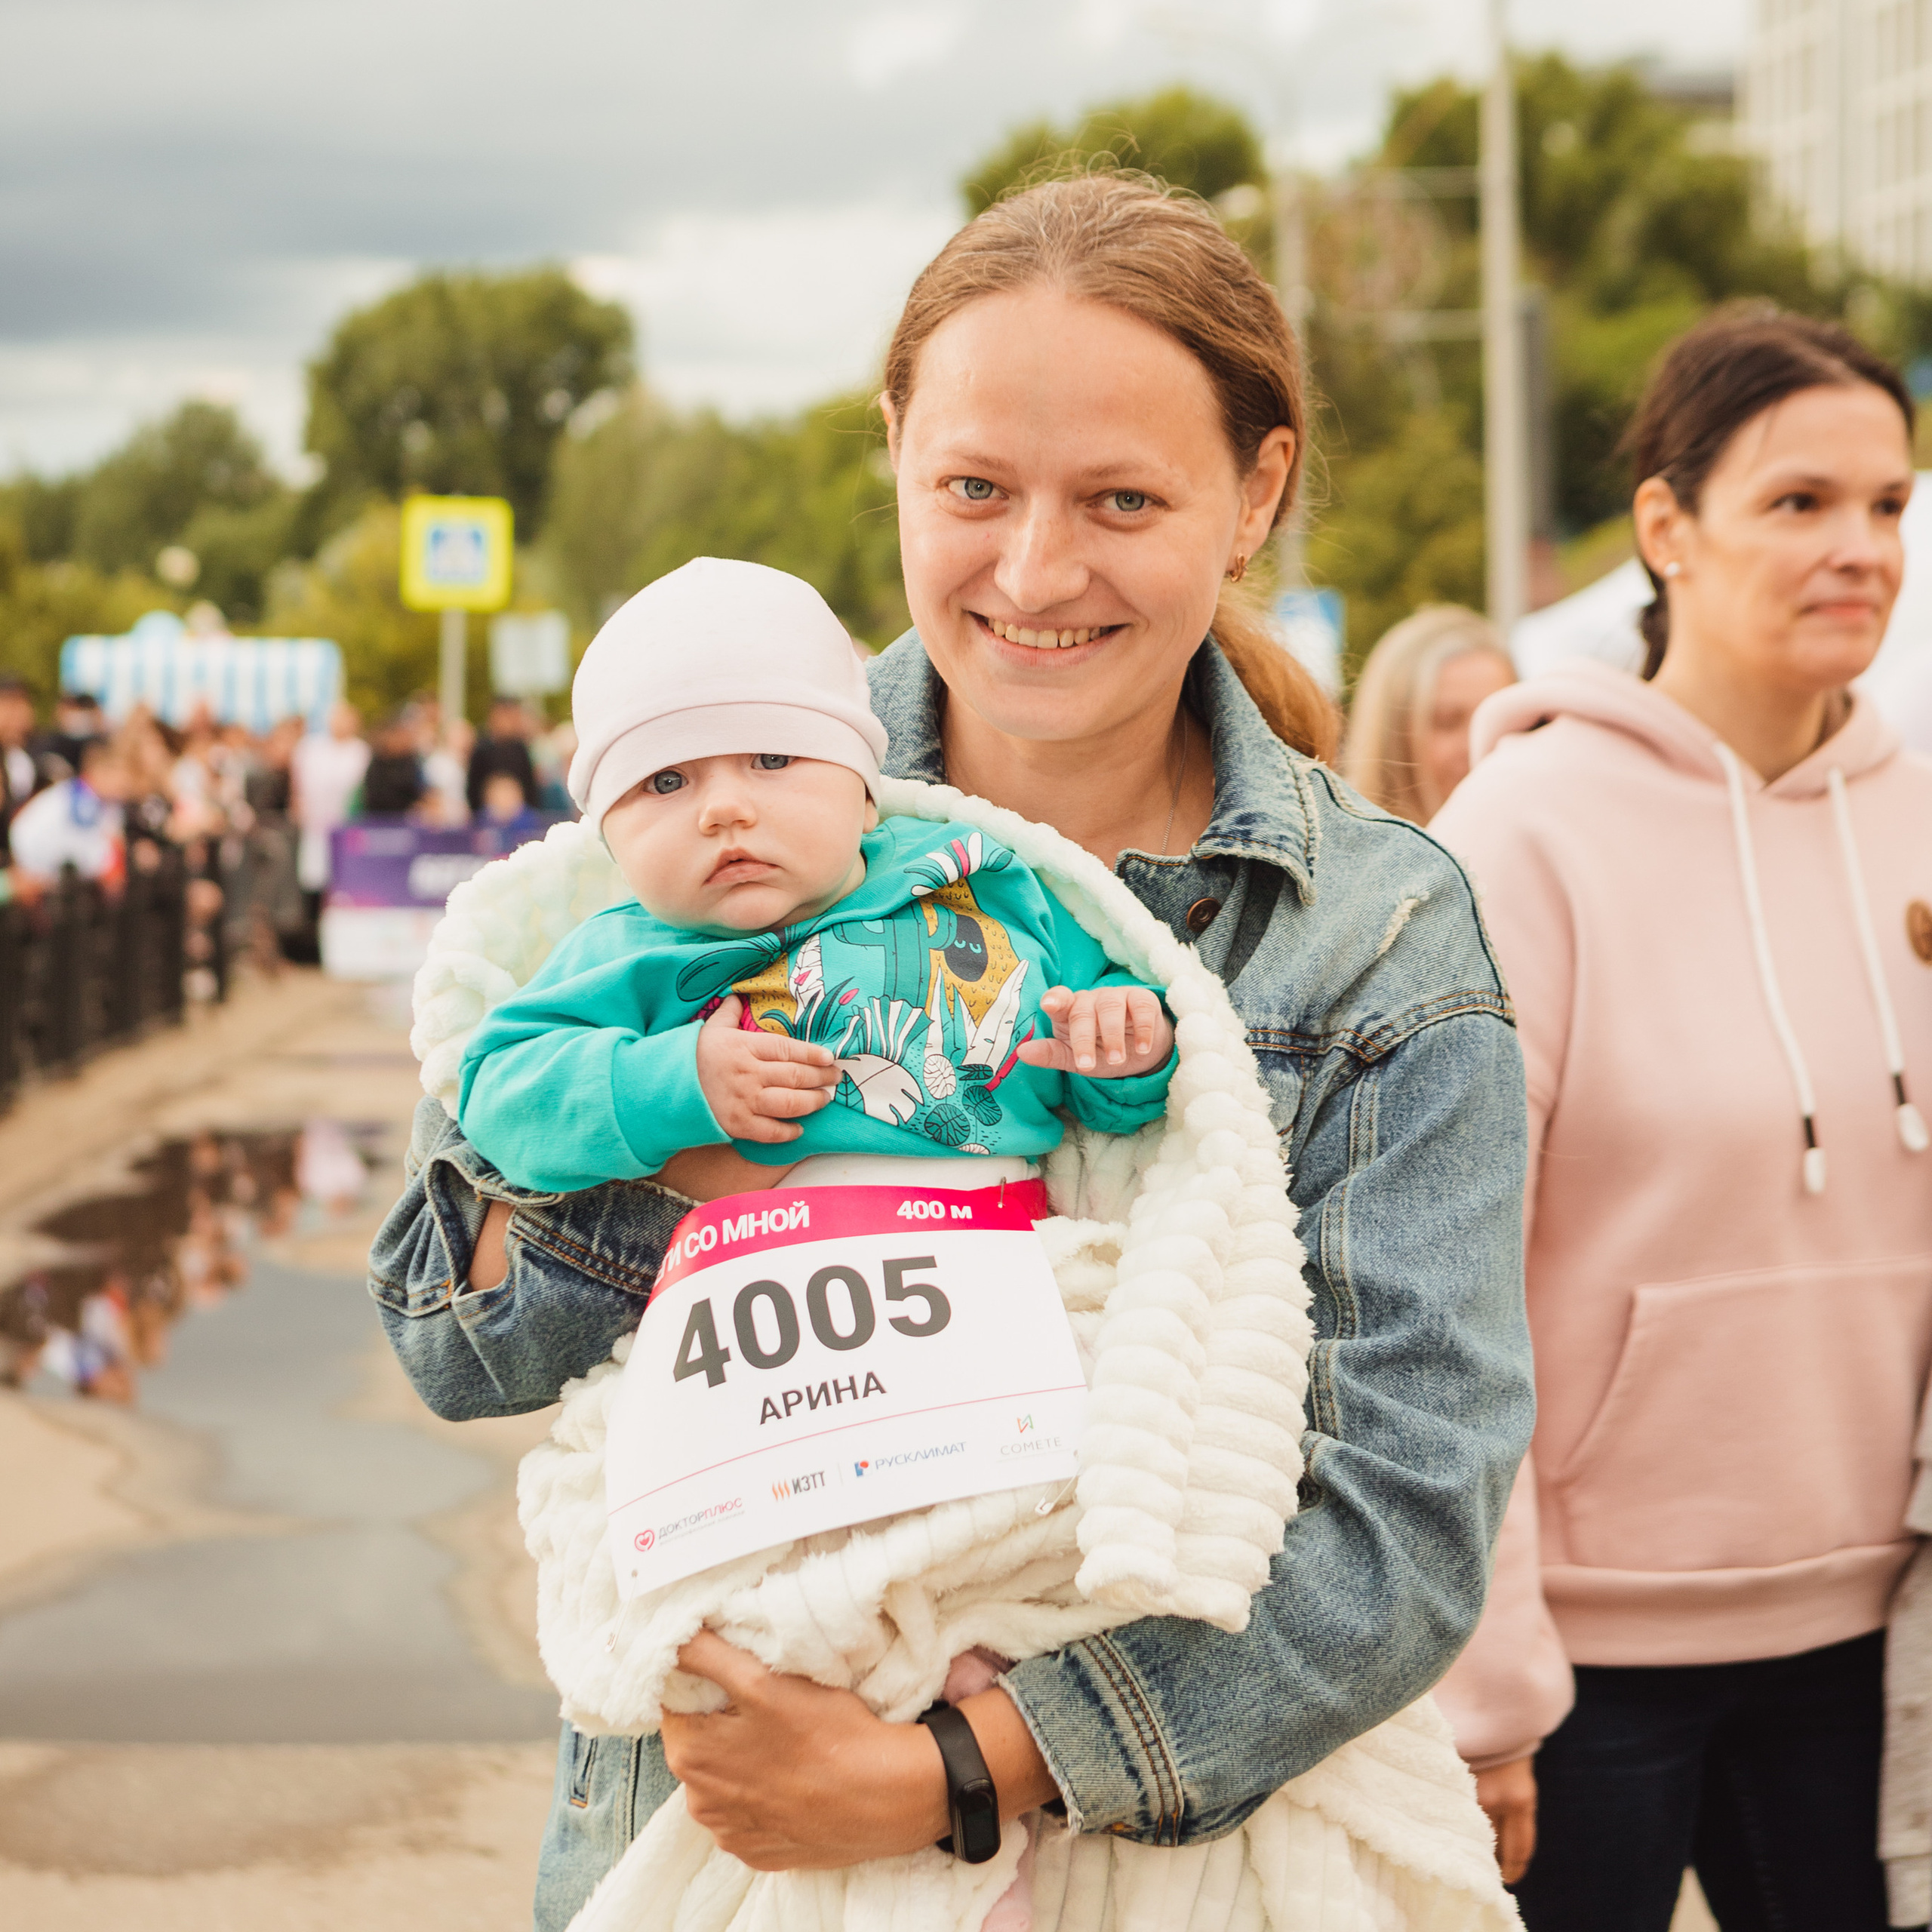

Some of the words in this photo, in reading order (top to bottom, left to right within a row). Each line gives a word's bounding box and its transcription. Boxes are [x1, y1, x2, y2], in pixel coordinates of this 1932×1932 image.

[684, 1225, 718, 1258] СО
[722, 1200, 810, 1245] МНОЙ
[897, 1200, 946, 1220] 400
[672, 1255, 952, 1389] 4005
[759, 1371, 887, 1425] АРИНА
[875, 1441, 967, 1470] РУСКЛИМАТ
[1000, 1437, 1062, 1455] COMETE
[658, 1497, 743, 1540] ДОКТОРПЛЮС
